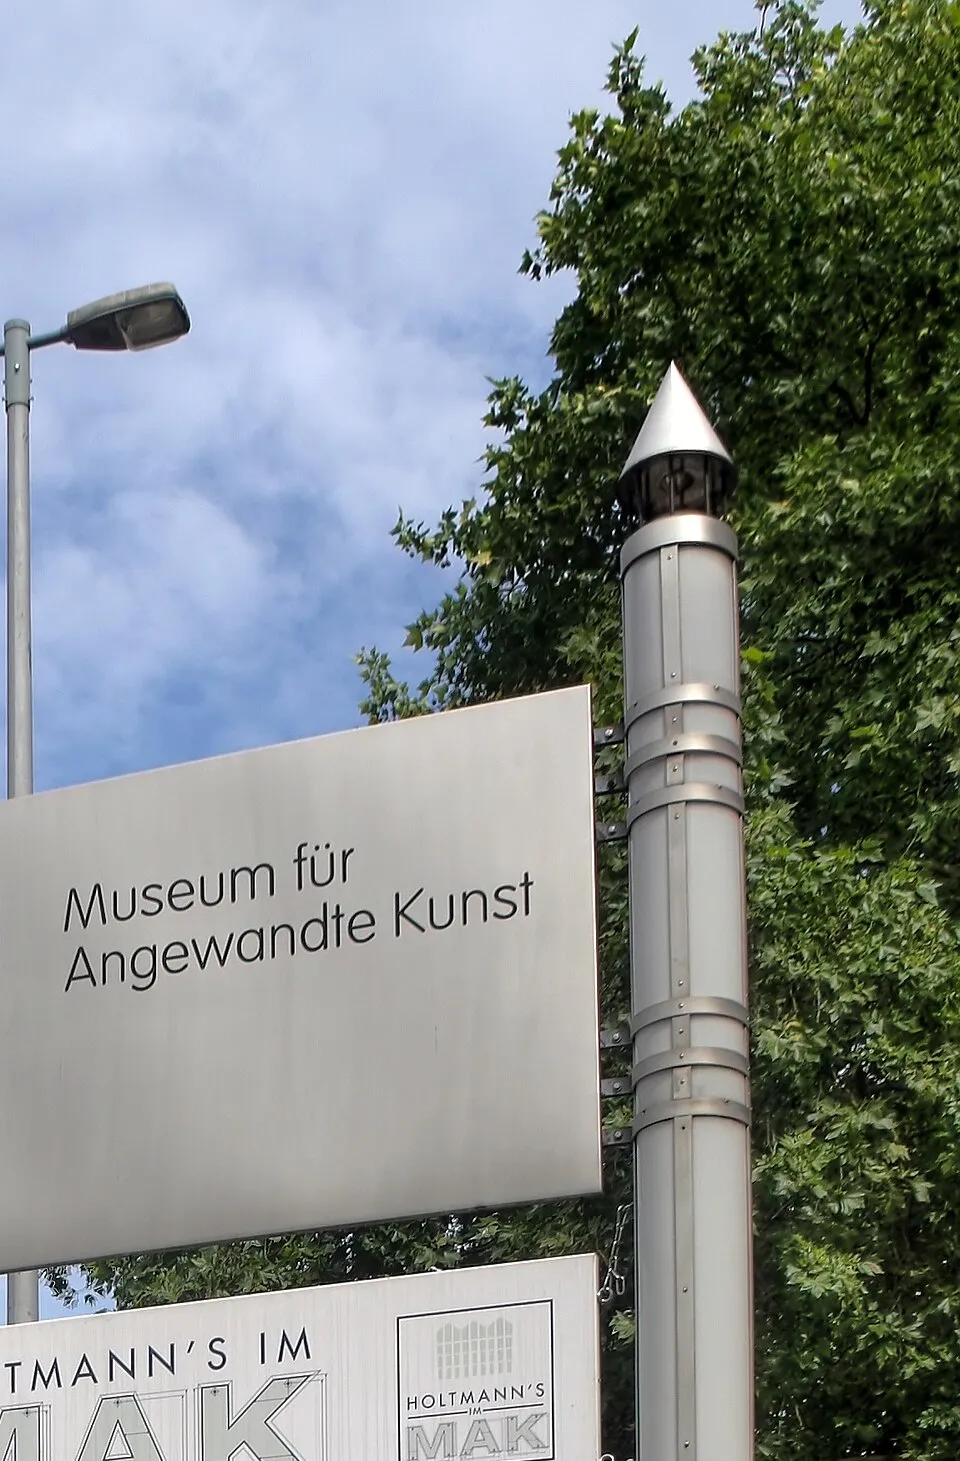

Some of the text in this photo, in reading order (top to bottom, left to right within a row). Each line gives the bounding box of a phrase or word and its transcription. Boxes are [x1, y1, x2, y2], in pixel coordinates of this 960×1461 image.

[63, 842, 356, 933] Museum für
[64, 871, 535, 993] Angewandte Kunst
[260, 1327, 311, 1364] IM
[407, 1383, 546, 1411] HOLTMANN'S
[468, 1407, 482, 1416] IM
[406, 1413, 550, 1461] MAK
